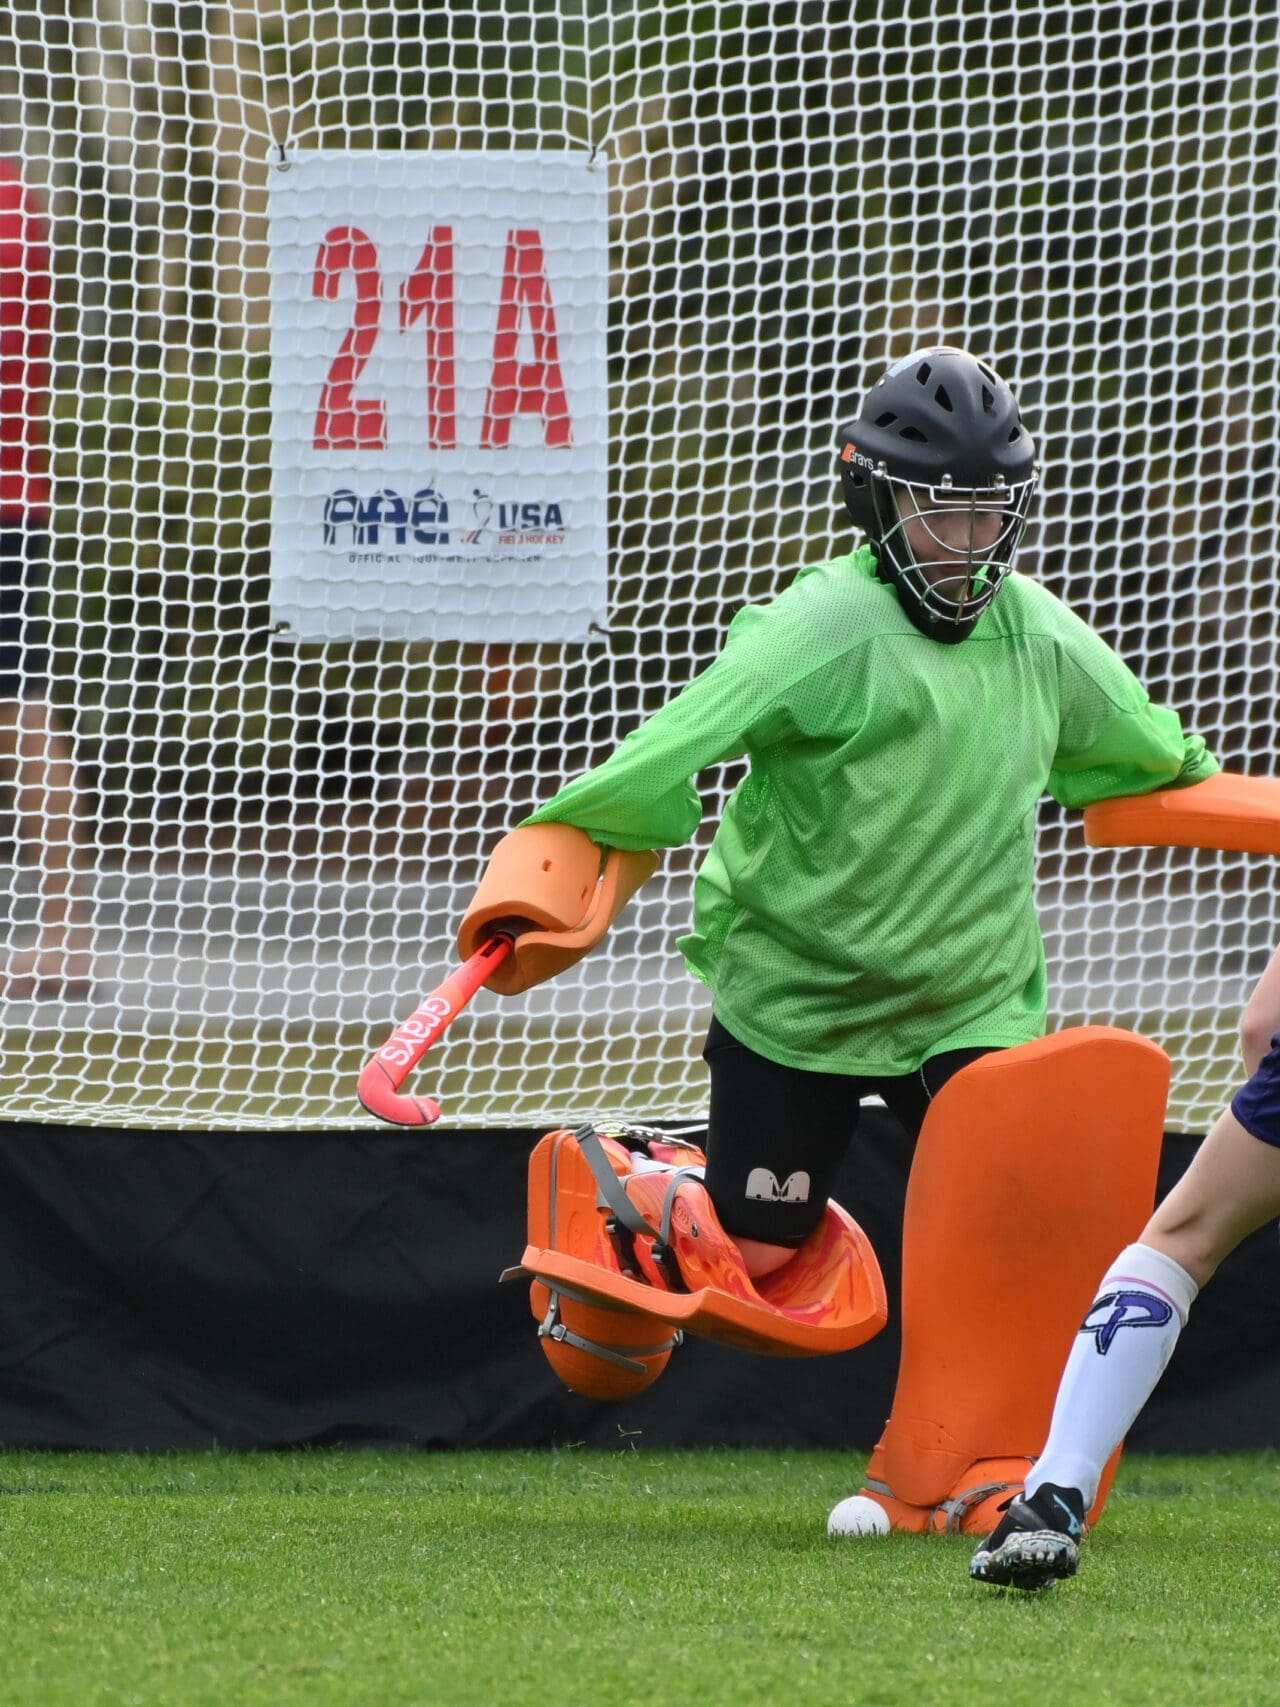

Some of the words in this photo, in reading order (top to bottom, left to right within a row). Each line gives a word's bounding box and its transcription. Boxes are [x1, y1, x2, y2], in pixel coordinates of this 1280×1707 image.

[312, 225, 573, 450] 21A
[499, 503, 564, 532] USA
[379, 997, 451, 1066] Grays
